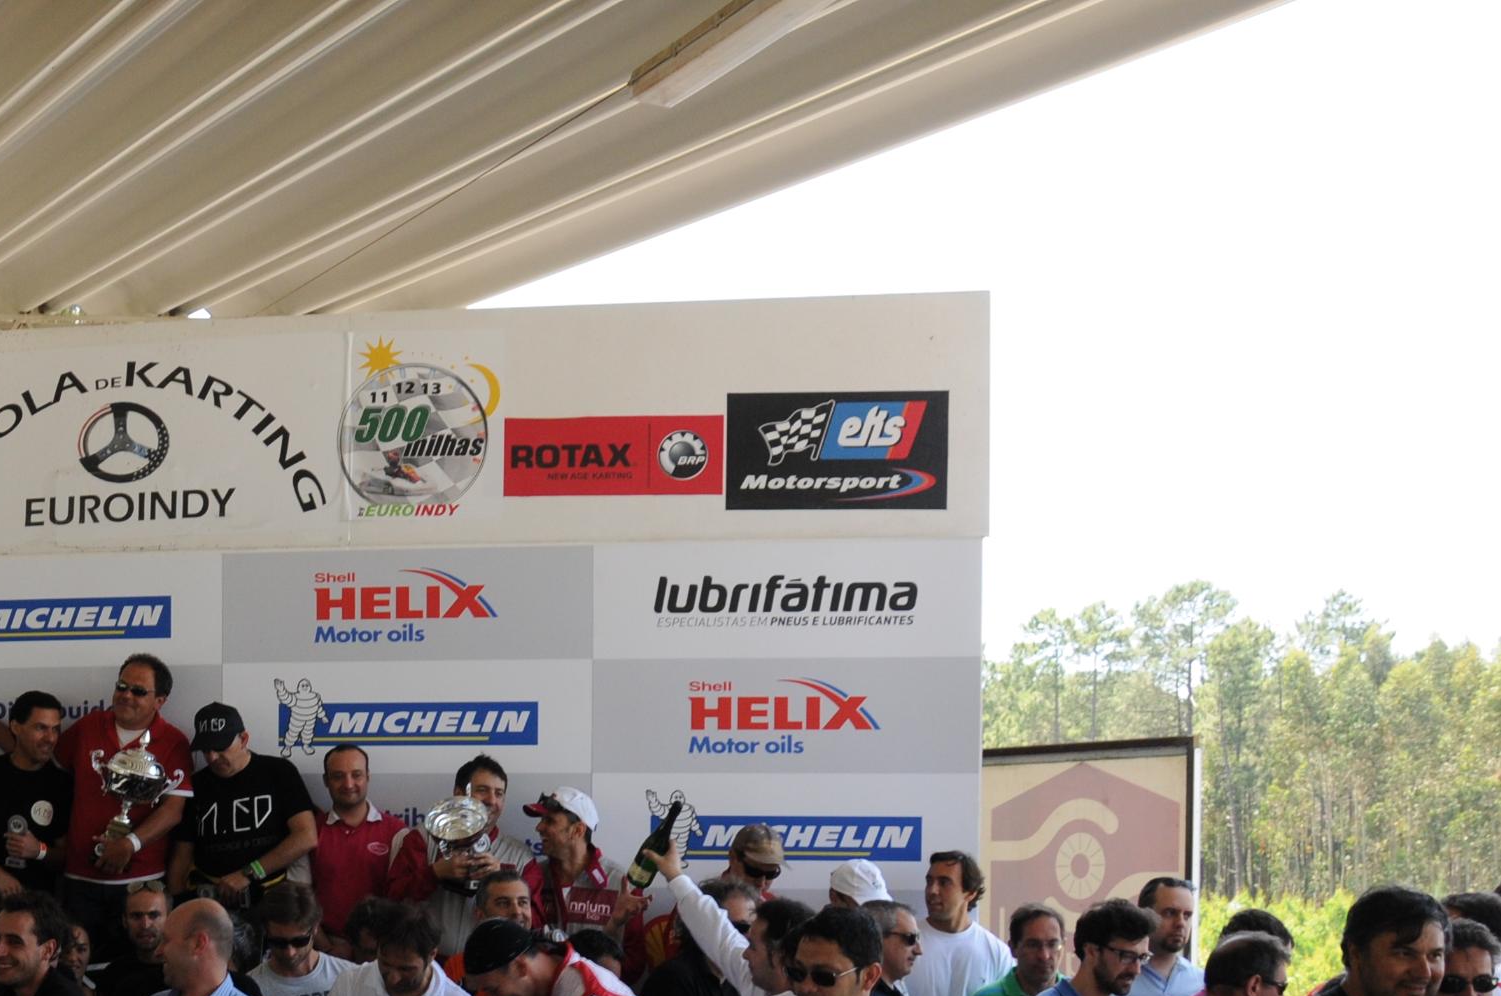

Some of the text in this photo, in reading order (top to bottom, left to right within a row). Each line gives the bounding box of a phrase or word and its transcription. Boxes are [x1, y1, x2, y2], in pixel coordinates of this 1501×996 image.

[370, 382, 442, 403] 11 12 13
[354, 405, 431, 443] 500
[95, 376, 122, 391] DE
[124, 361, 326, 513] KARTING
[403, 433, 484, 457] milhas
[510, 443, 632, 469] ROTAX
[677, 455, 706, 466] BRP
[740, 473, 904, 495] Motorsport
[24, 487, 236, 527] EUROINDY
[365, 504, 460, 517] EUROINDY
[314, 572, 355, 584] Shell
[314, 583, 493, 621] HELIX
[656, 615, 915, 628] ESPECIALISTAS EM PNEUS E LUBRIFICANTES
[314, 623, 425, 644] Motor oils
[688, 681, 731, 692] Shell
[329, 710, 530, 733] MICHELIN
[689, 695, 877, 730] HELIX
[688, 733, 804, 755] Motor oils
